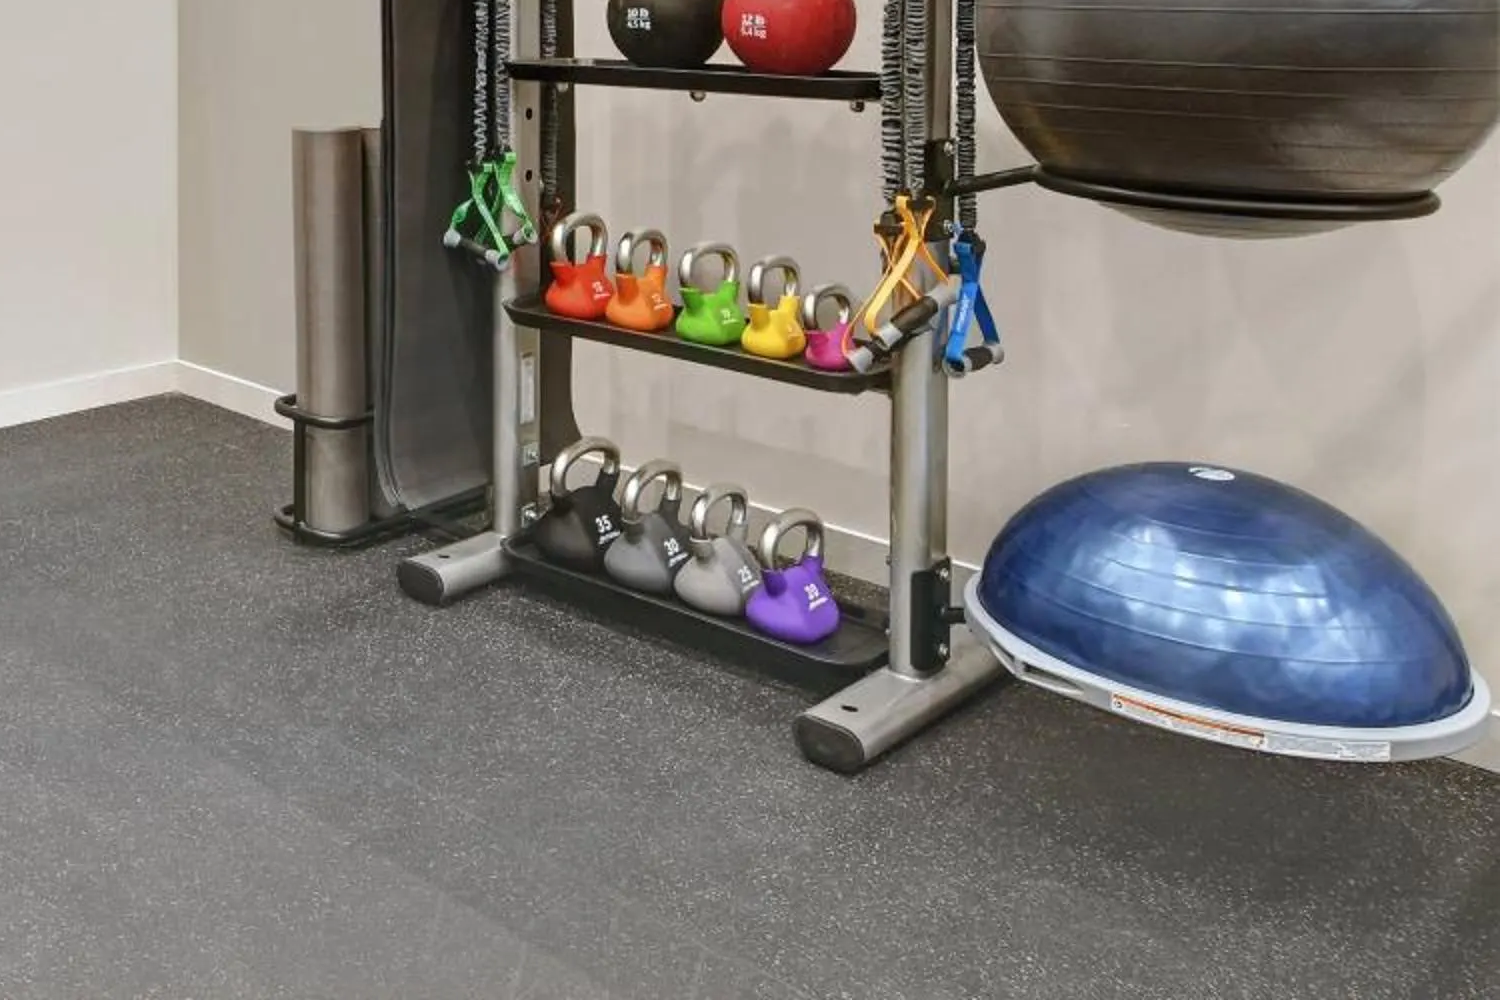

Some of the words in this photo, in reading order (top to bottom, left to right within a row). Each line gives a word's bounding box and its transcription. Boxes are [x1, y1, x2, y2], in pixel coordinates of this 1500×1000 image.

[627, 7, 638, 18] 10
[639, 7, 649, 18] lb
[639, 18, 651, 31] kg
[595, 514, 613, 534] 35
[663, 538, 680, 556] 30
[737, 565, 753, 583] 25
